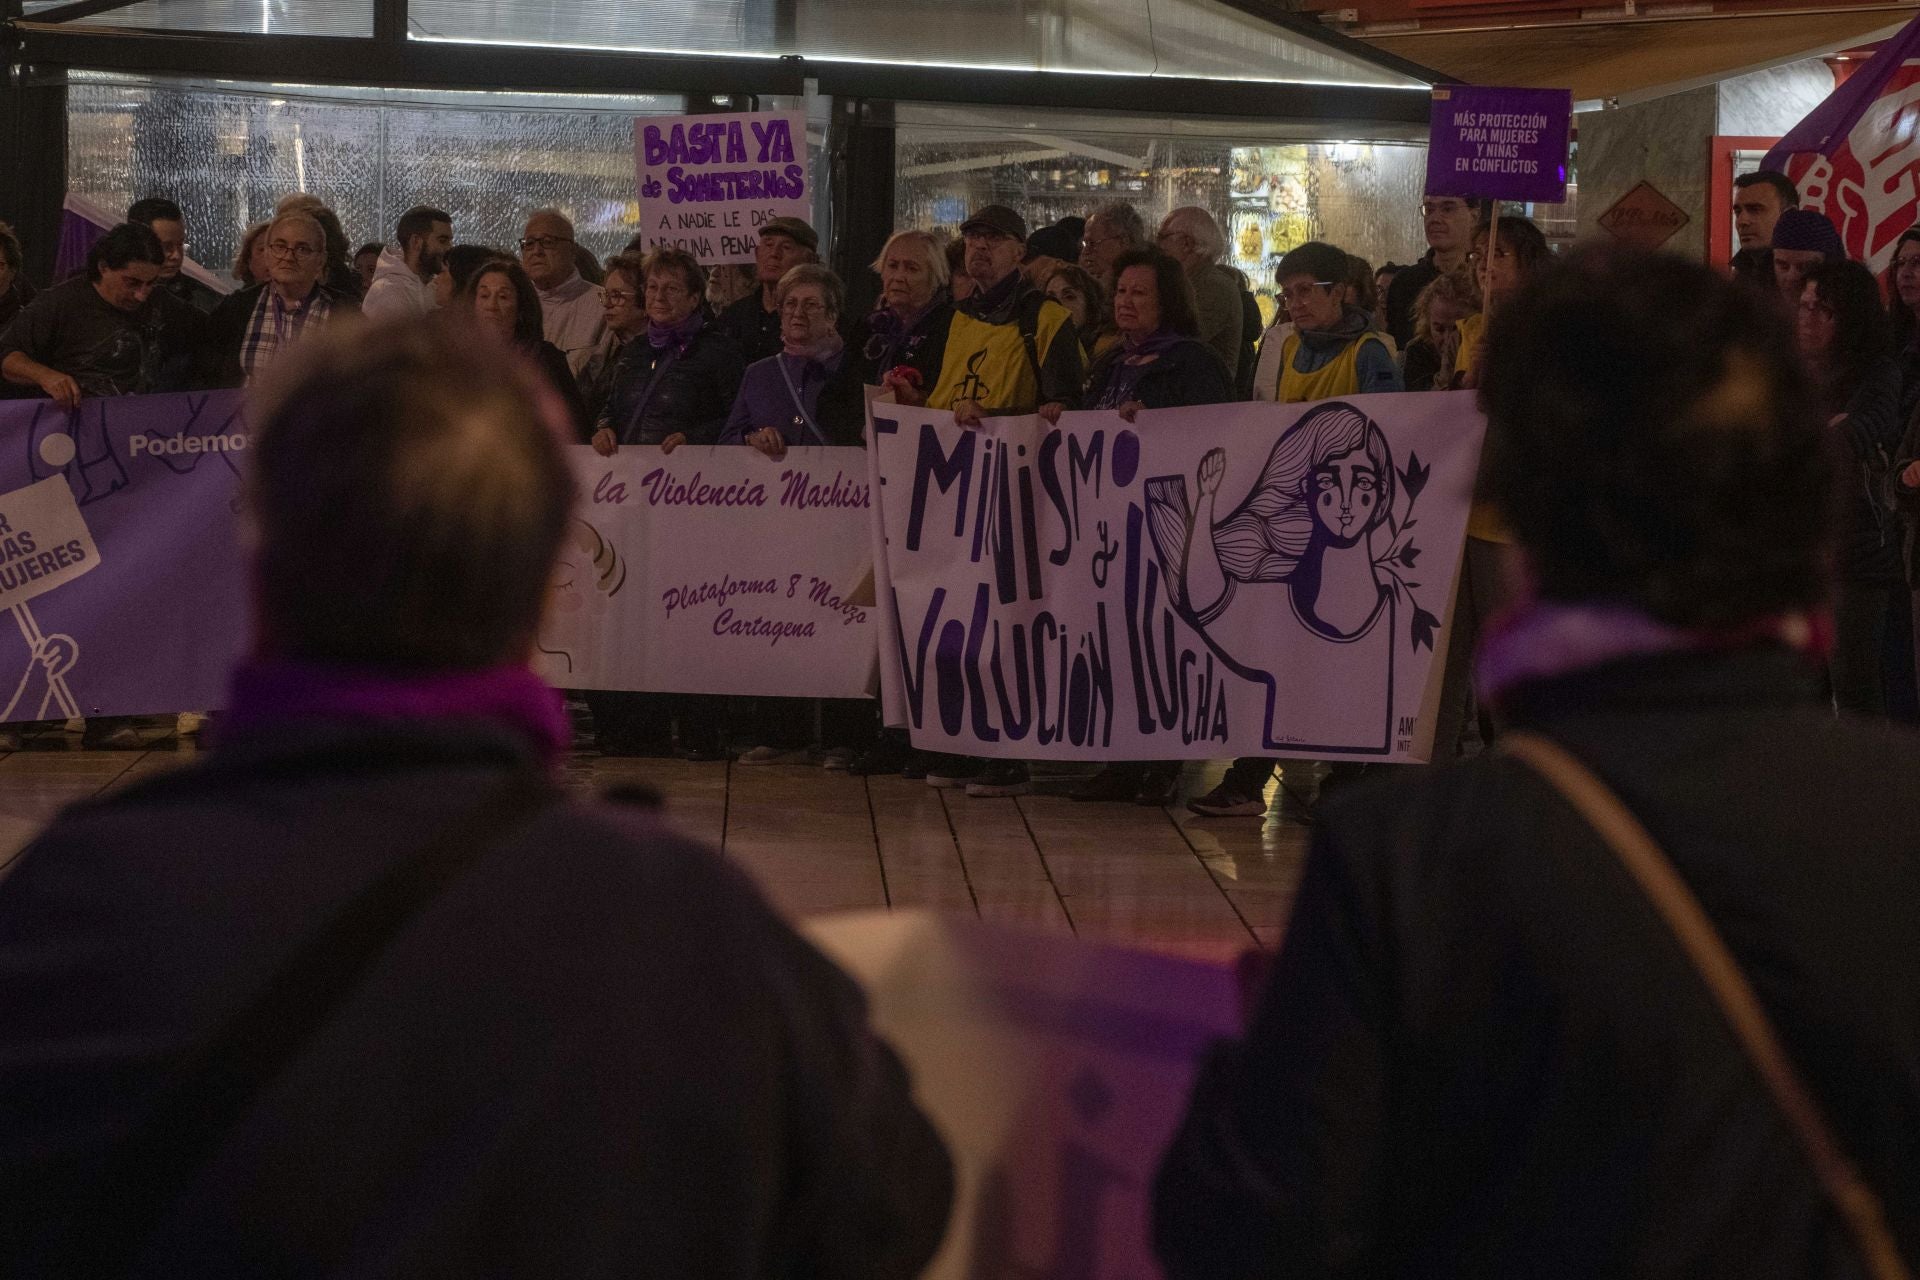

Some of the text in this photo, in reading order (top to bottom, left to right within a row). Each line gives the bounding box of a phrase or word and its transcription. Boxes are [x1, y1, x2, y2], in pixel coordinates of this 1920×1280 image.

[1453, 110, 1547, 129] MÁS PROTECCIÓN
[643, 120, 795, 165] BASTA YA
[1460, 128, 1539, 144] PARA MUJERES
[1476, 143, 1484, 157] Y
[1455, 157, 1538, 174] EN CONFLICTOS
[659, 214, 672, 229] A
[724, 211, 741, 227] LE
[751, 209, 777, 227] DAS
[592, 470, 629, 504] la
[641, 467, 767, 506] Violencia
[0, 531, 36, 565] AS
[0, 540, 87, 593] UJERES
[662, 574, 867, 626] Plataforma 8 Marzo
[713, 608, 817, 647] Cartagena
[1398, 717, 1418, 737] AM
